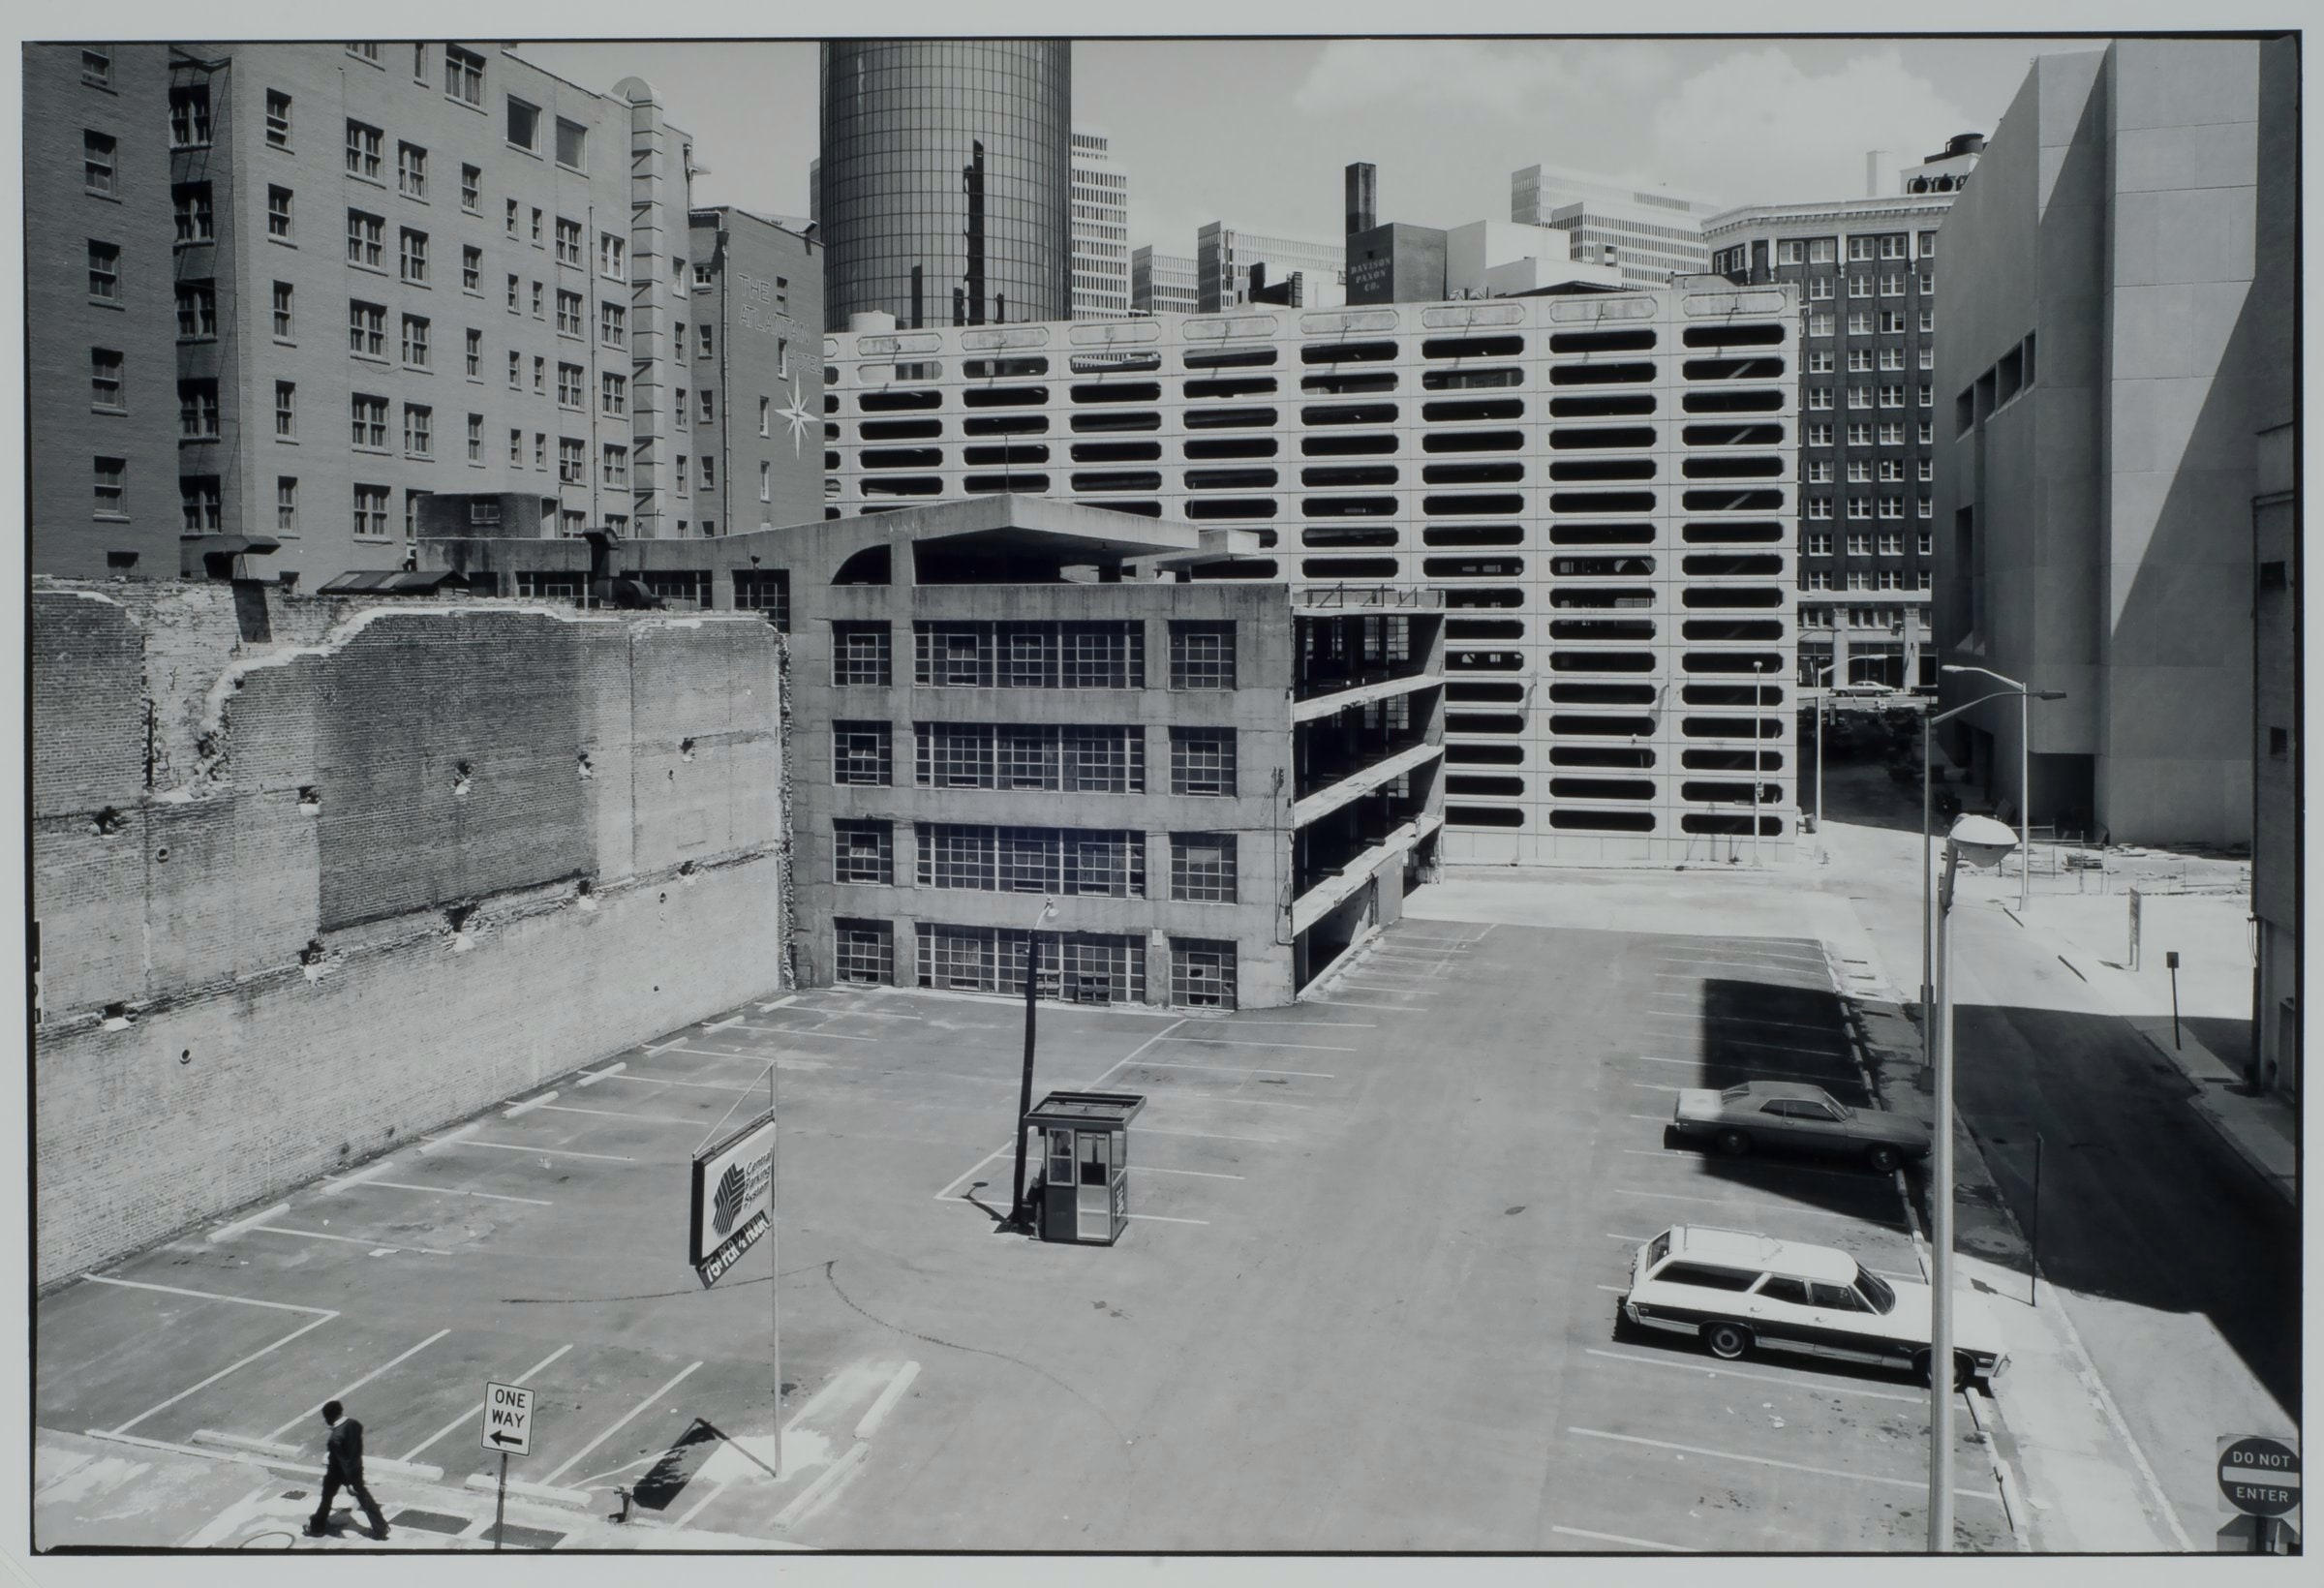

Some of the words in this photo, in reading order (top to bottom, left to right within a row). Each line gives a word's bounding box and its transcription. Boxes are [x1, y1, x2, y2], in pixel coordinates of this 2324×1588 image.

[1350, 258, 1391, 275] DAVISON
[1355, 269, 1386, 284] PAXON
[737, 271, 772, 304] THE
[1364, 282, 1380, 292] CO.
[739, 303, 812, 346] ATLANTAN
[788, 349, 824, 376] HOTEL
[747, 1146, 773, 1176] Central
[745, 1165, 771, 1190] Parking
[744, 1180, 770, 1209] System
[719, 1239, 740, 1267] PER
[743, 1211, 770, 1243] HOUR
[495, 1389, 526, 1408] ONE
[492, 1409, 525, 1428] WAY
[2232, 1451, 2254, 1464] DO
[2259, 1453, 2290, 1467] NOT
[2236, 1486, 2289, 1503] ENTER
